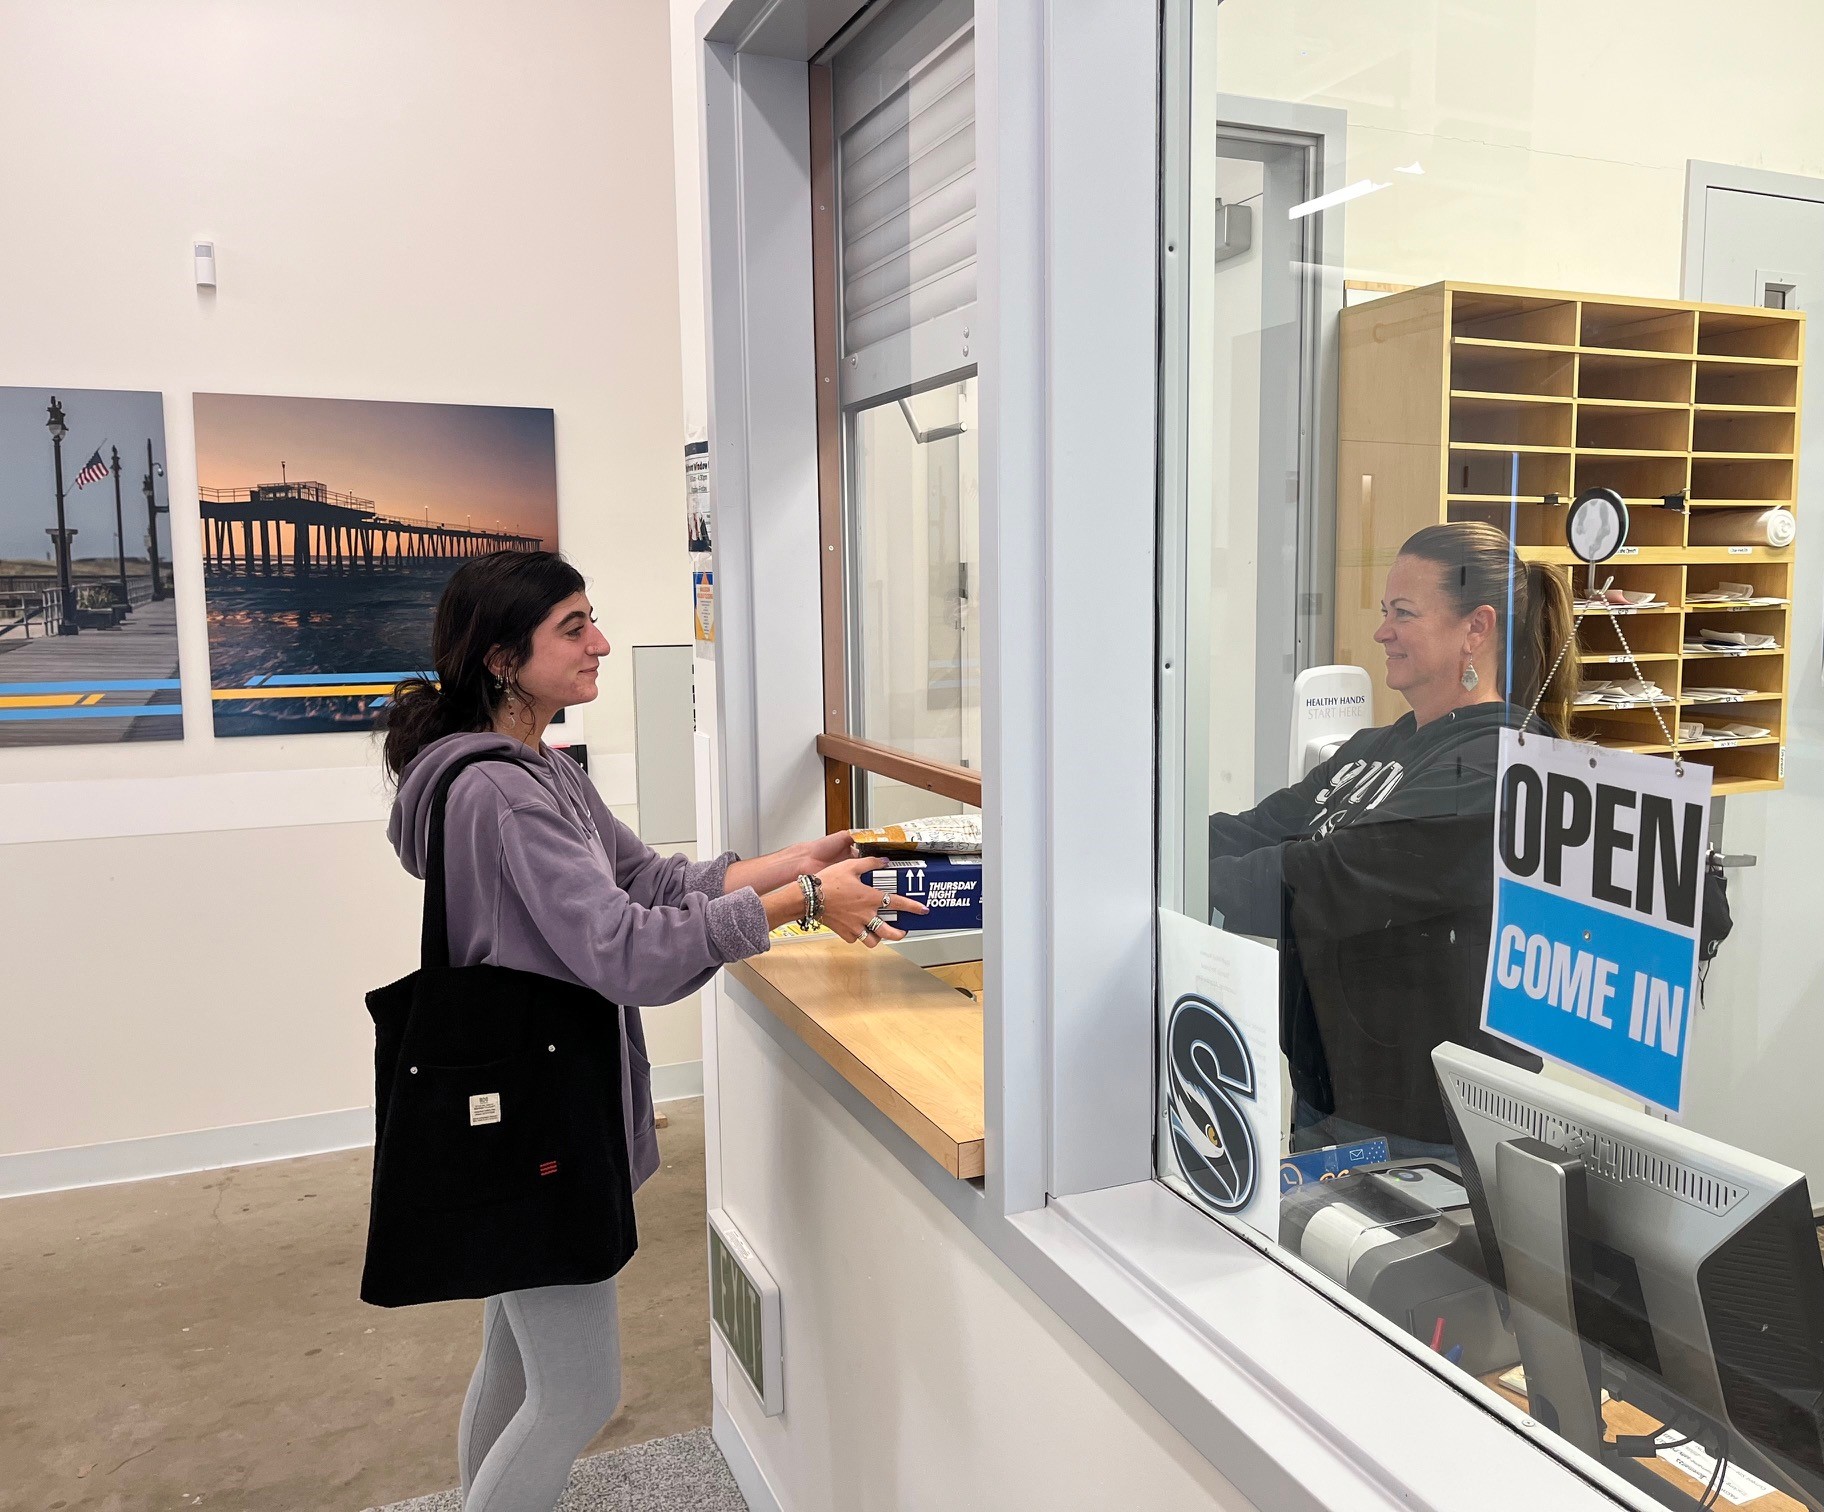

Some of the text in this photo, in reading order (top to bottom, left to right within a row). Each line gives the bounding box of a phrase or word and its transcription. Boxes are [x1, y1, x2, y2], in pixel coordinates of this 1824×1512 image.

[1306, 695, 1366, 707] HEALTHY HANDS
[1308, 706, 1362, 720] START HERE
[1499, 763, 1703, 929] OPEN
[929, 881, 978, 891] THURSDAY
[928, 890, 957, 899] NIGHT
[926, 898, 971, 908] FOOTBALL
[1496, 923, 1685, 1058] COME IN
